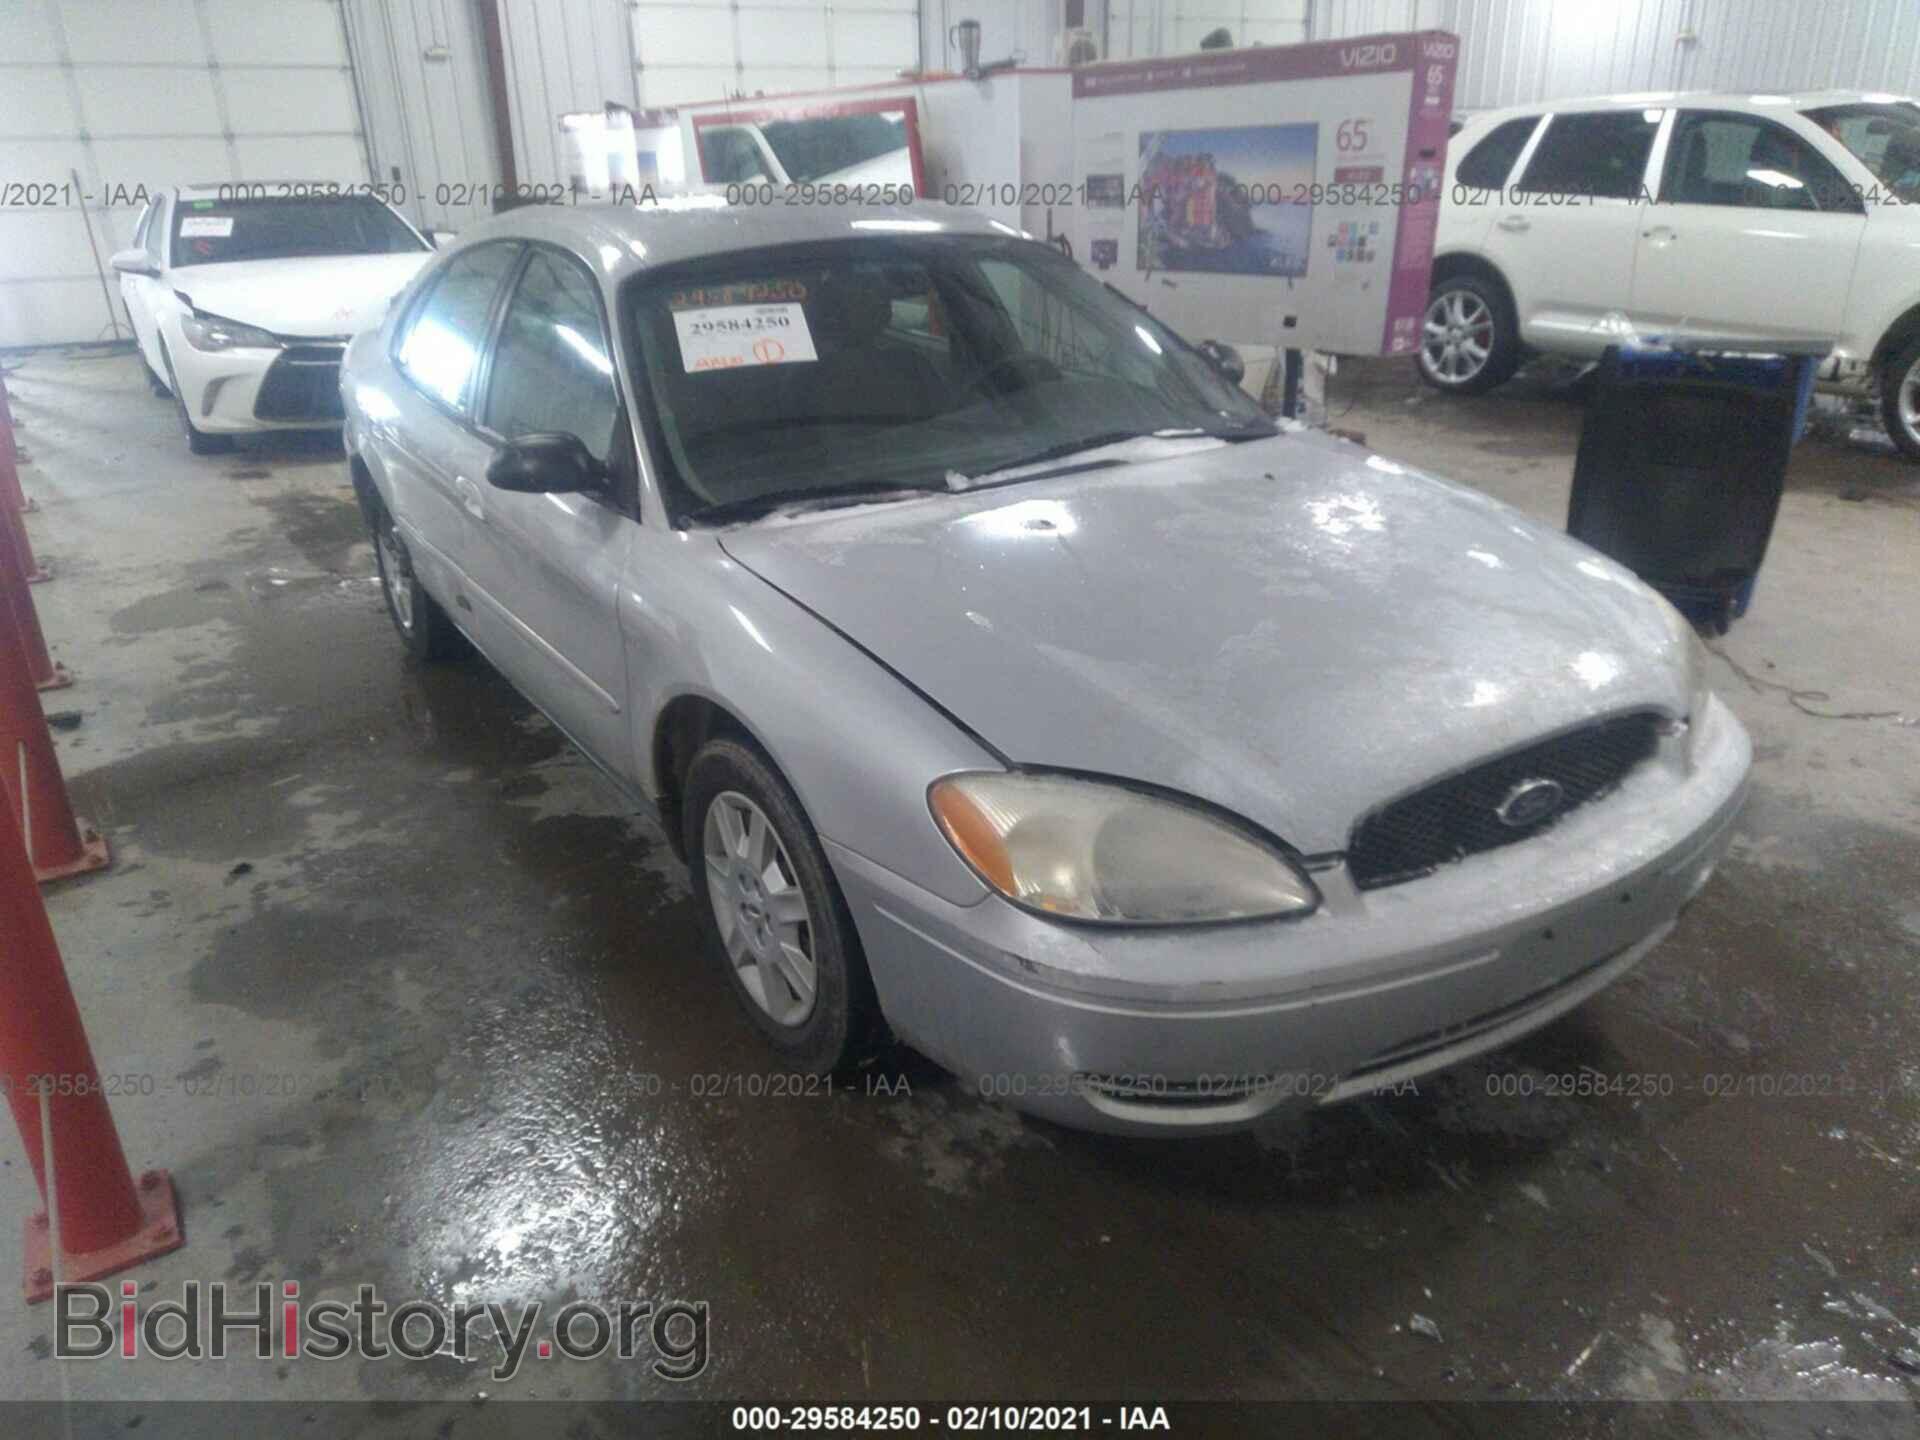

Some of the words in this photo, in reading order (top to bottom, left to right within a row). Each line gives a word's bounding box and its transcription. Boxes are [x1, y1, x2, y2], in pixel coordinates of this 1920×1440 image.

[1340, 44, 1397, 67] VIZIO
[1336, 118, 1369, 152] 65
[689, 314, 791, 336] 29584250
